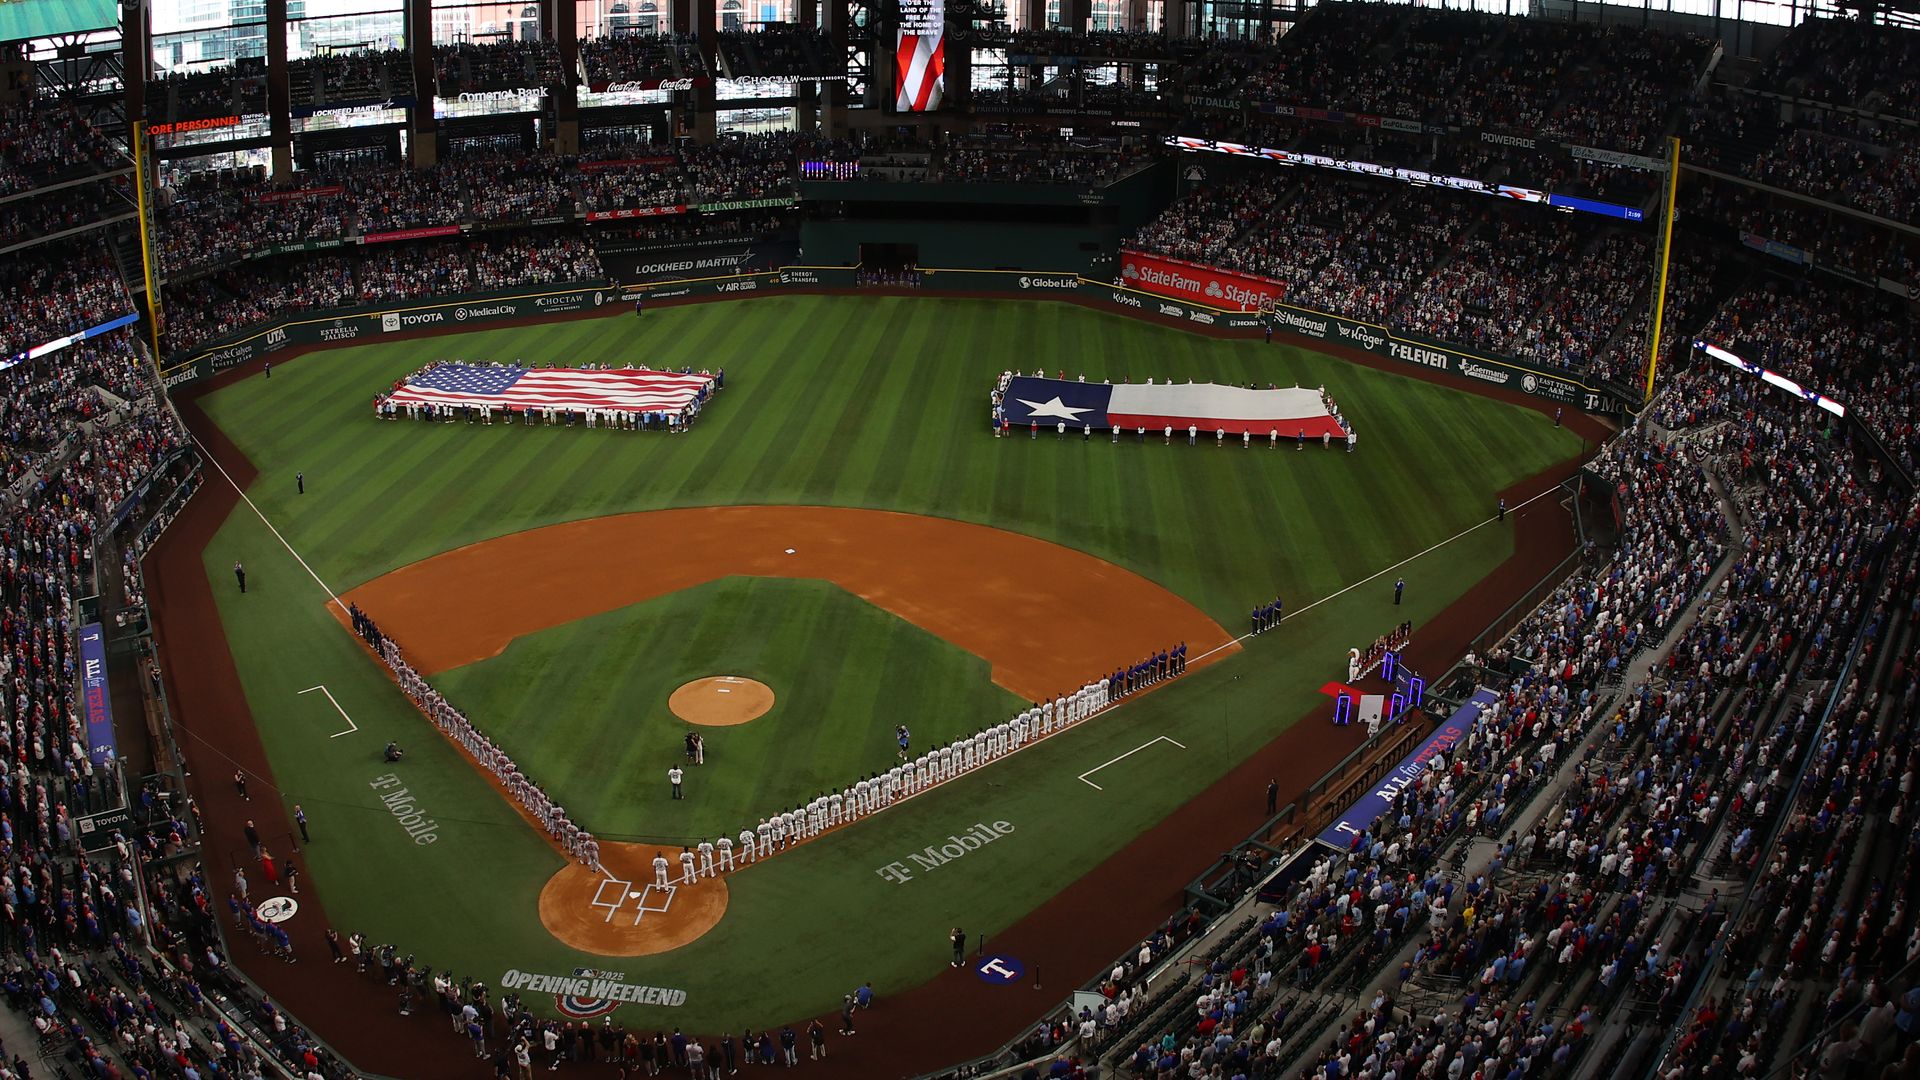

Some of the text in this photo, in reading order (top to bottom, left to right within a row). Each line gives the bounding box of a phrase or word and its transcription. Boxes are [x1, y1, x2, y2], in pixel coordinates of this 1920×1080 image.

[743, 75, 800, 84] CHOCTAW
[517, 86, 549, 98] Bank
[1205, 98, 1241, 110] DALLAS
[1275, 106, 1294, 115] 105.3
[312, 105, 382, 117] LOCKHEED MARTIN
[175, 116, 240, 133] PERSONNEL
[1480, 131, 1536, 149] POWERADE
[1287, 153, 1301, 161] O'ER
[1303, 156, 1315, 164] THE
[1317, 157, 1334, 167] LAND
[1347, 162, 1360, 171] THE
[1361, 164, 1376, 174] FREE
[1378, 167, 1393, 176] AND
[1395, 169, 1408, 178] THE
[1410, 172, 1430, 182] HOME
[1444, 178, 1457, 186] THE
[1458, 180, 1484, 190] BRAVE
[707, 198, 792, 211] LUXOR STAFFING
[635, 257, 738, 275] LOCKHEED MARTIN
[725, 282, 739, 292] AIR
[539, 295, 583, 306] CHOCTAW
[1112, 292, 1142, 308] Kubota
[469, 305, 516, 318] Medical City
[401, 312, 444, 325] TOYOTA
[1285, 313, 1328, 332] National
[266, 328, 287, 345] UTA
[320, 326, 359, 336] ESTRELLA
[323, 332, 356, 341] JALISCO
[1298, 327, 1325, 338] Car Rental
[1351, 326, 1385, 350] Kroger
[1472, 364, 1509, 381] Germania
[1539, 377, 1576, 393] EAST TEXAS
[1548, 386, 1564, 396] A&M
[1537, 391, 1574, 404] UNIVERSITY
[84, 658, 106, 724] ALL for TEXAS
[1415, 727, 1462, 764] TEXAS
[1399, 762, 1424, 780] for
[1376, 776, 1413, 802] ALL
[95, 814, 128, 827] TOYOTA
[980, 957, 1018, 979] T
[598, 970, 625, 981] 2025
[501, 969, 687, 1007] OPENING WEEKEND
